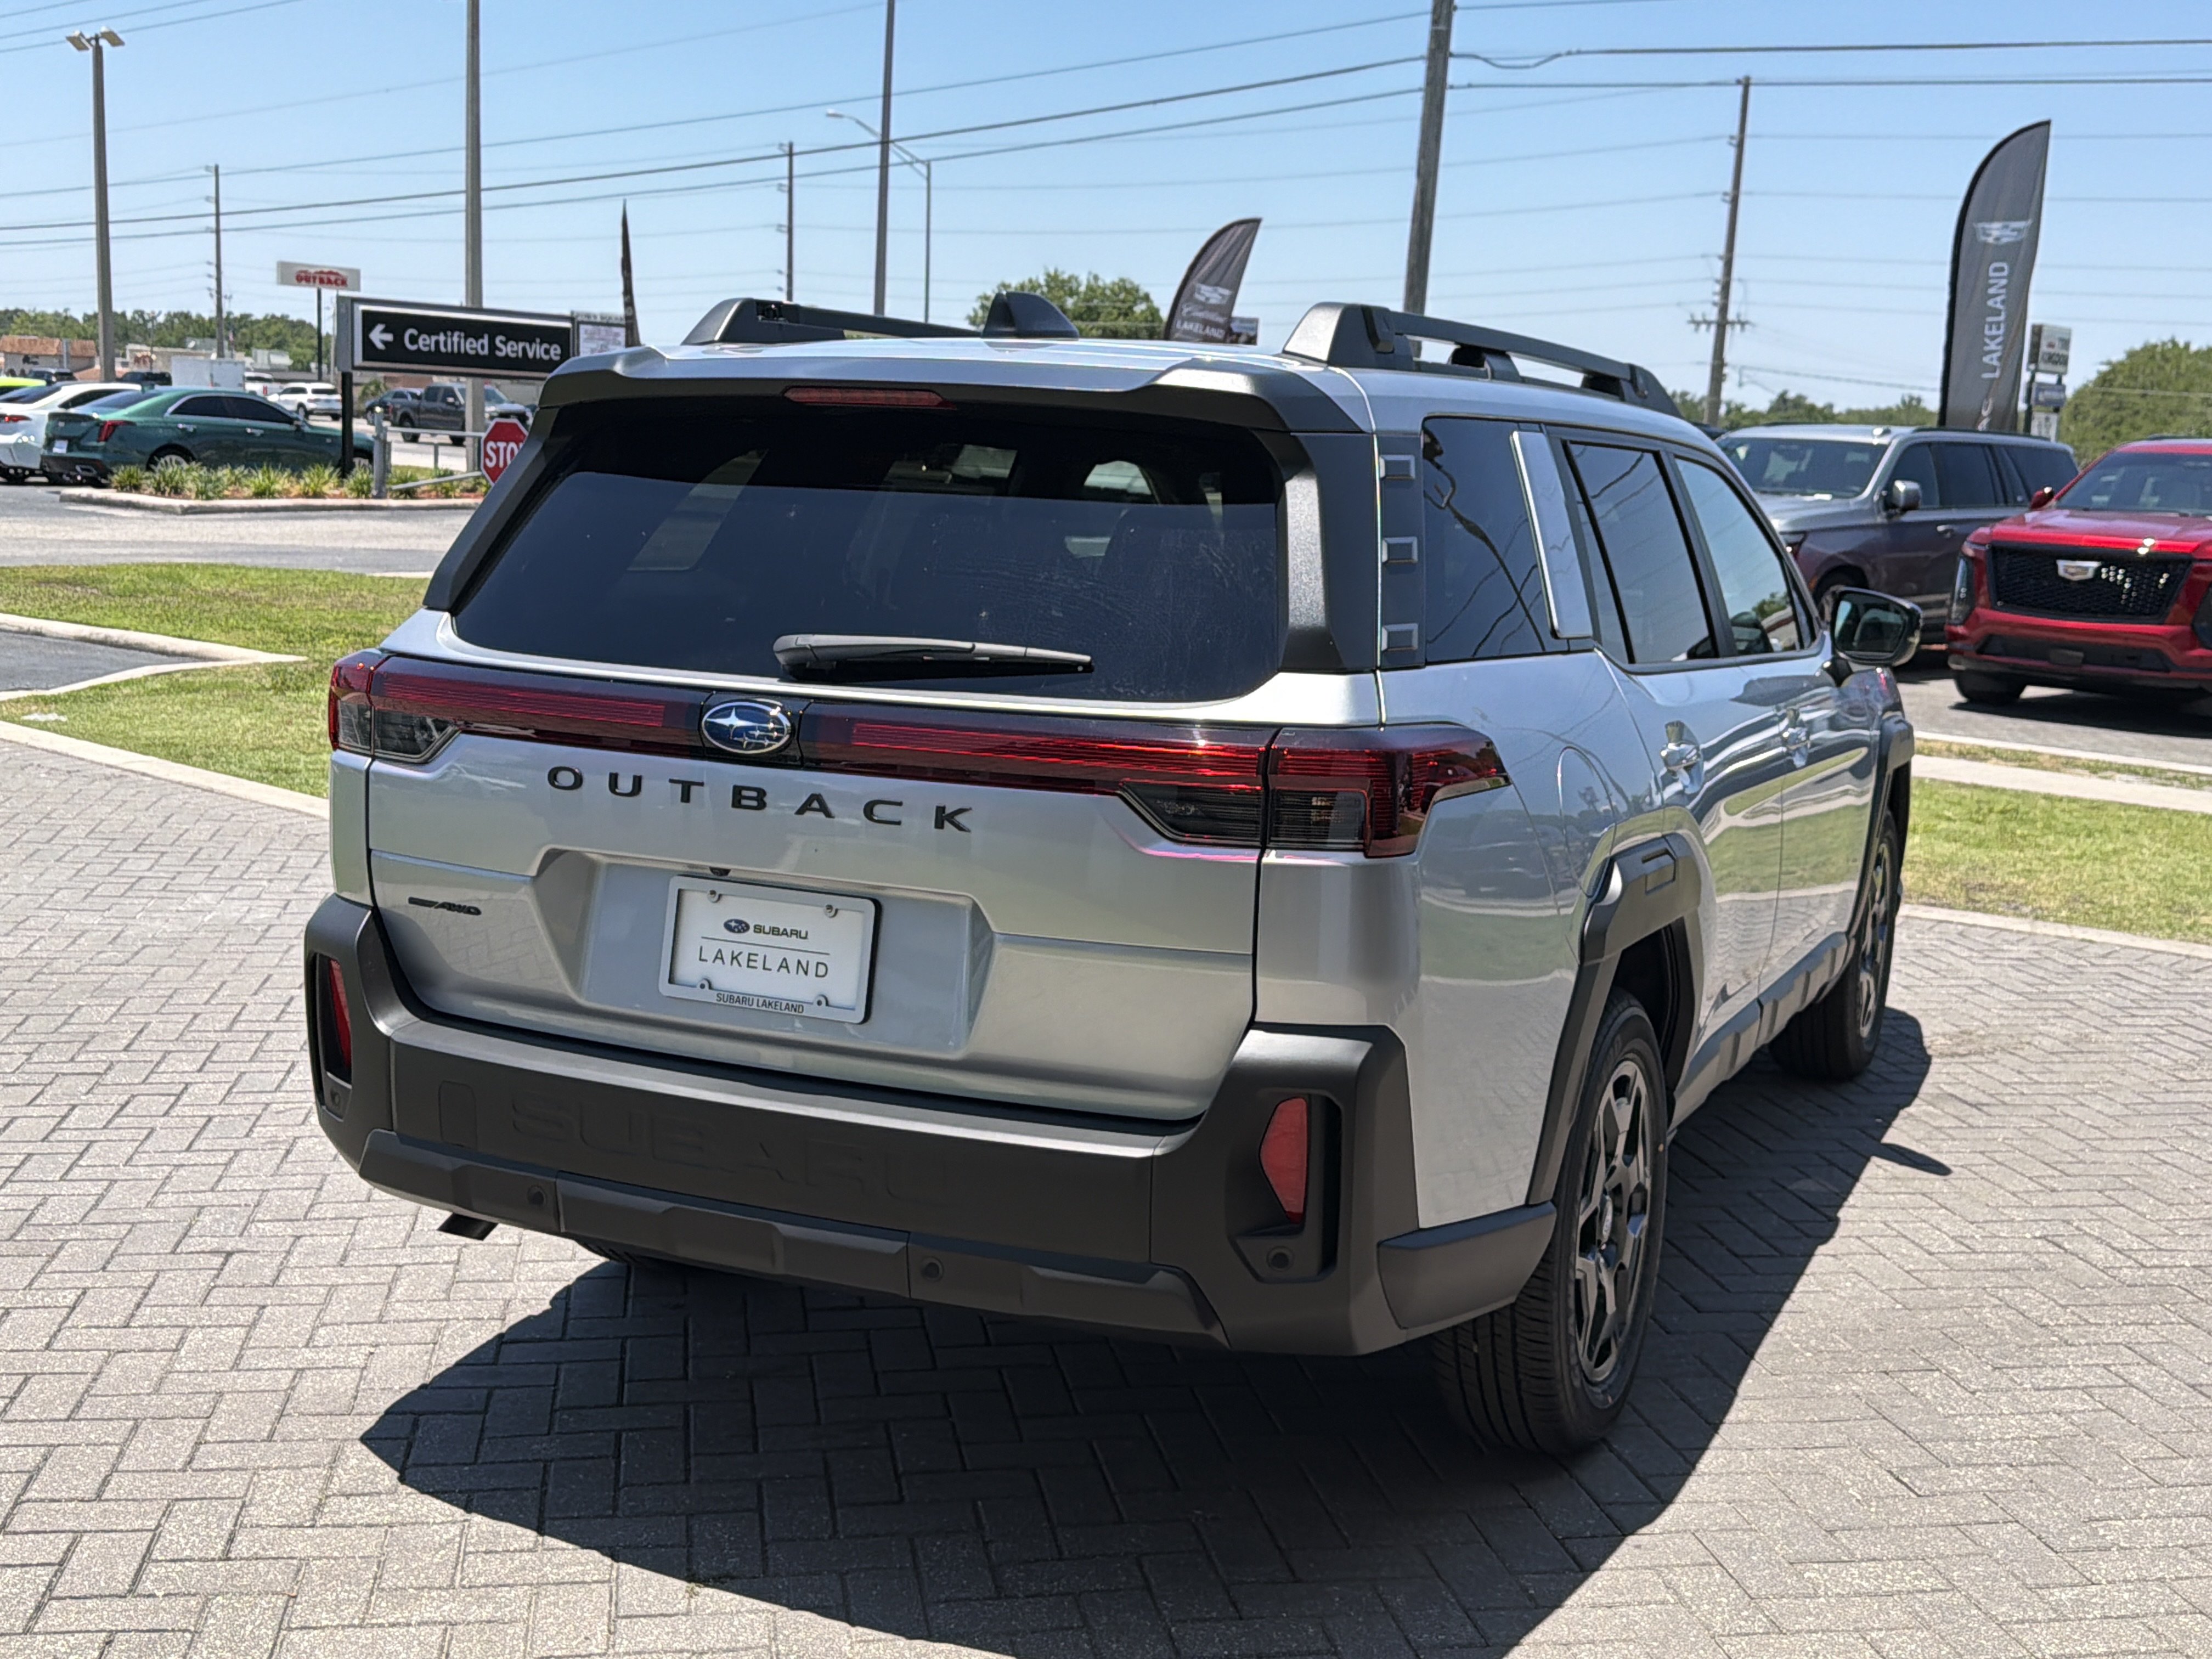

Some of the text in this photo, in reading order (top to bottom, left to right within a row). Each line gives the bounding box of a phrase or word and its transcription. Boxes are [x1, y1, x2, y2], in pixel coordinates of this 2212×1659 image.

[295, 274, 348, 287] OUTBACK
[1982, 262, 2009, 379] LAKELAND
[404, 328, 489, 356] Certified
[495, 335, 562, 361] Service
[486, 441, 523, 468] STO
[547, 766, 972, 833] OUTBACK
[753, 924, 809, 940] SUBARU
[698, 945, 829, 979] LAKELAND
[716, 992, 804, 1014] SUBARU LAKELAND
[510, 1090, 948, 1201] SUBARU
